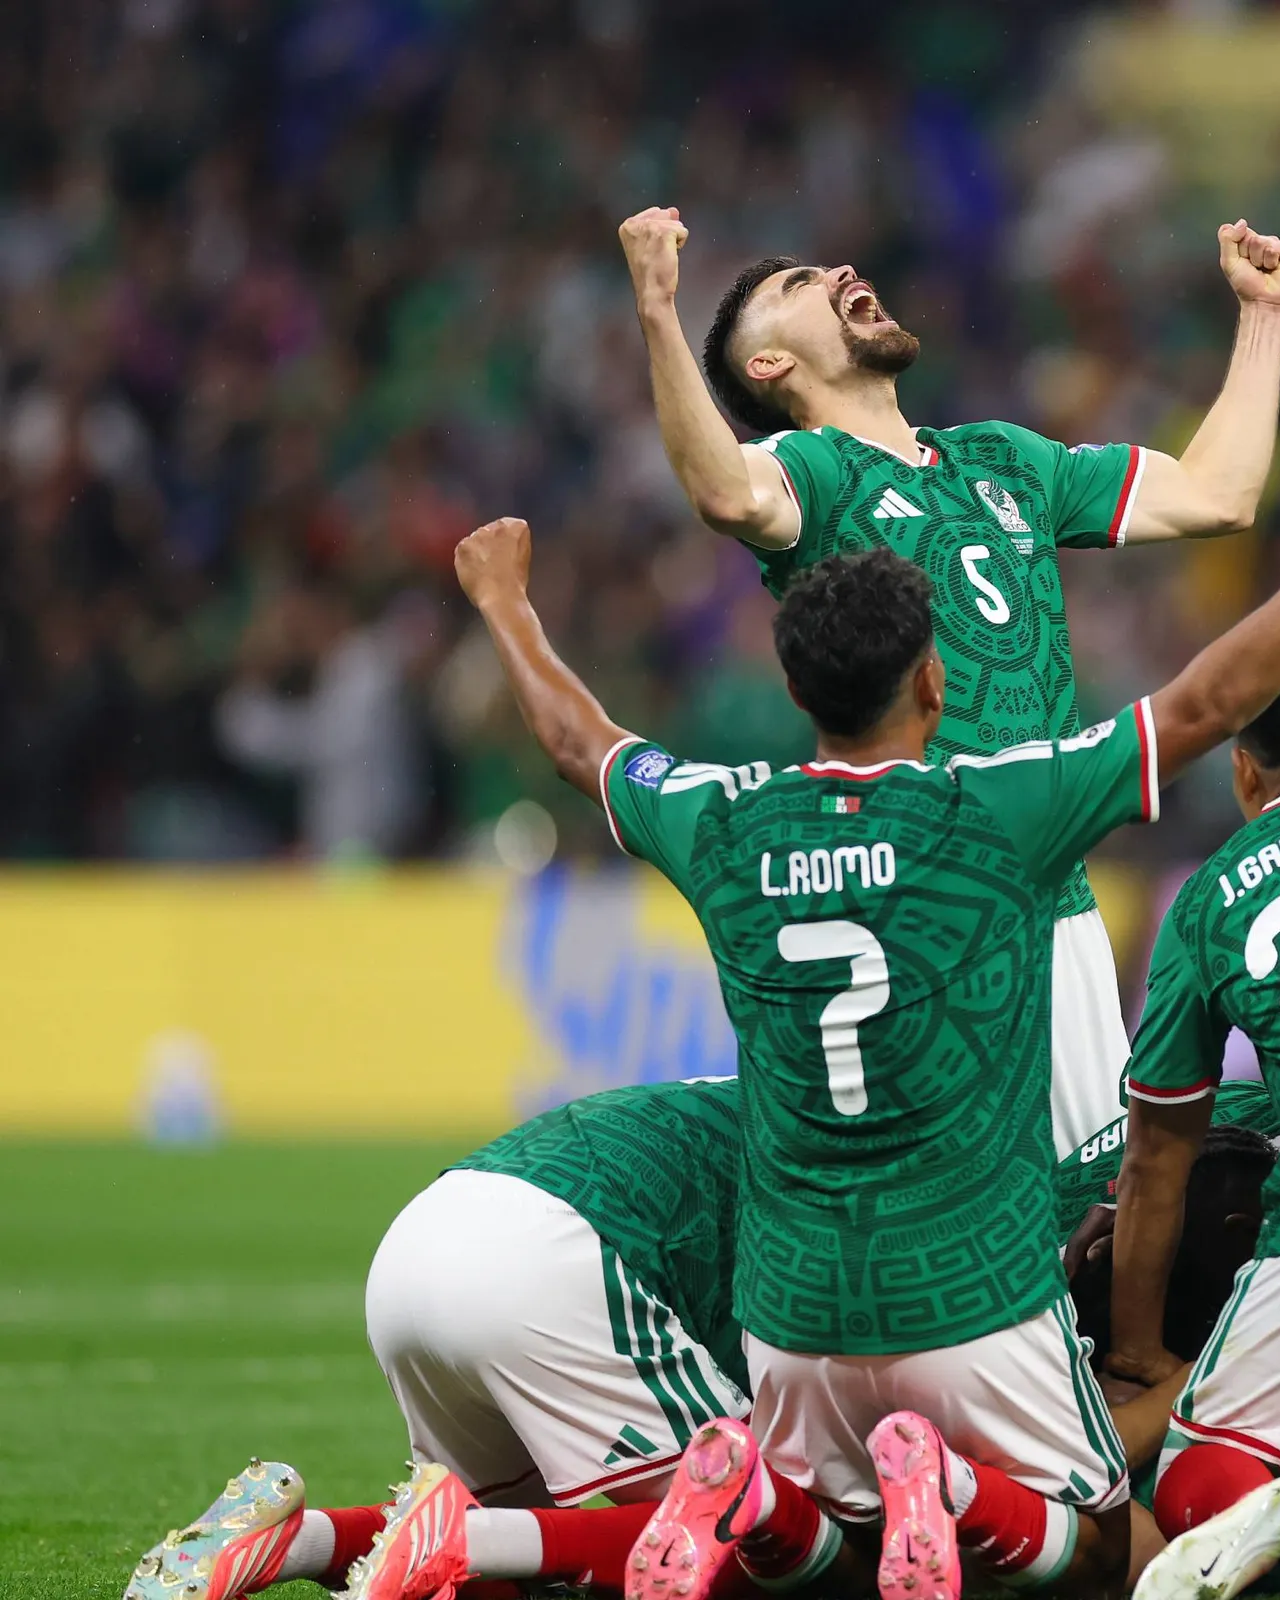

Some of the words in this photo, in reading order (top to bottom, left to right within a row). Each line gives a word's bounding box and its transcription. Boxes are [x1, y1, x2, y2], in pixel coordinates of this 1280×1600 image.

[960, 544, 1011, 625] 5
[761, 842, 897, 897] L.ROMO
[777, 920, 890, 1117] 7
